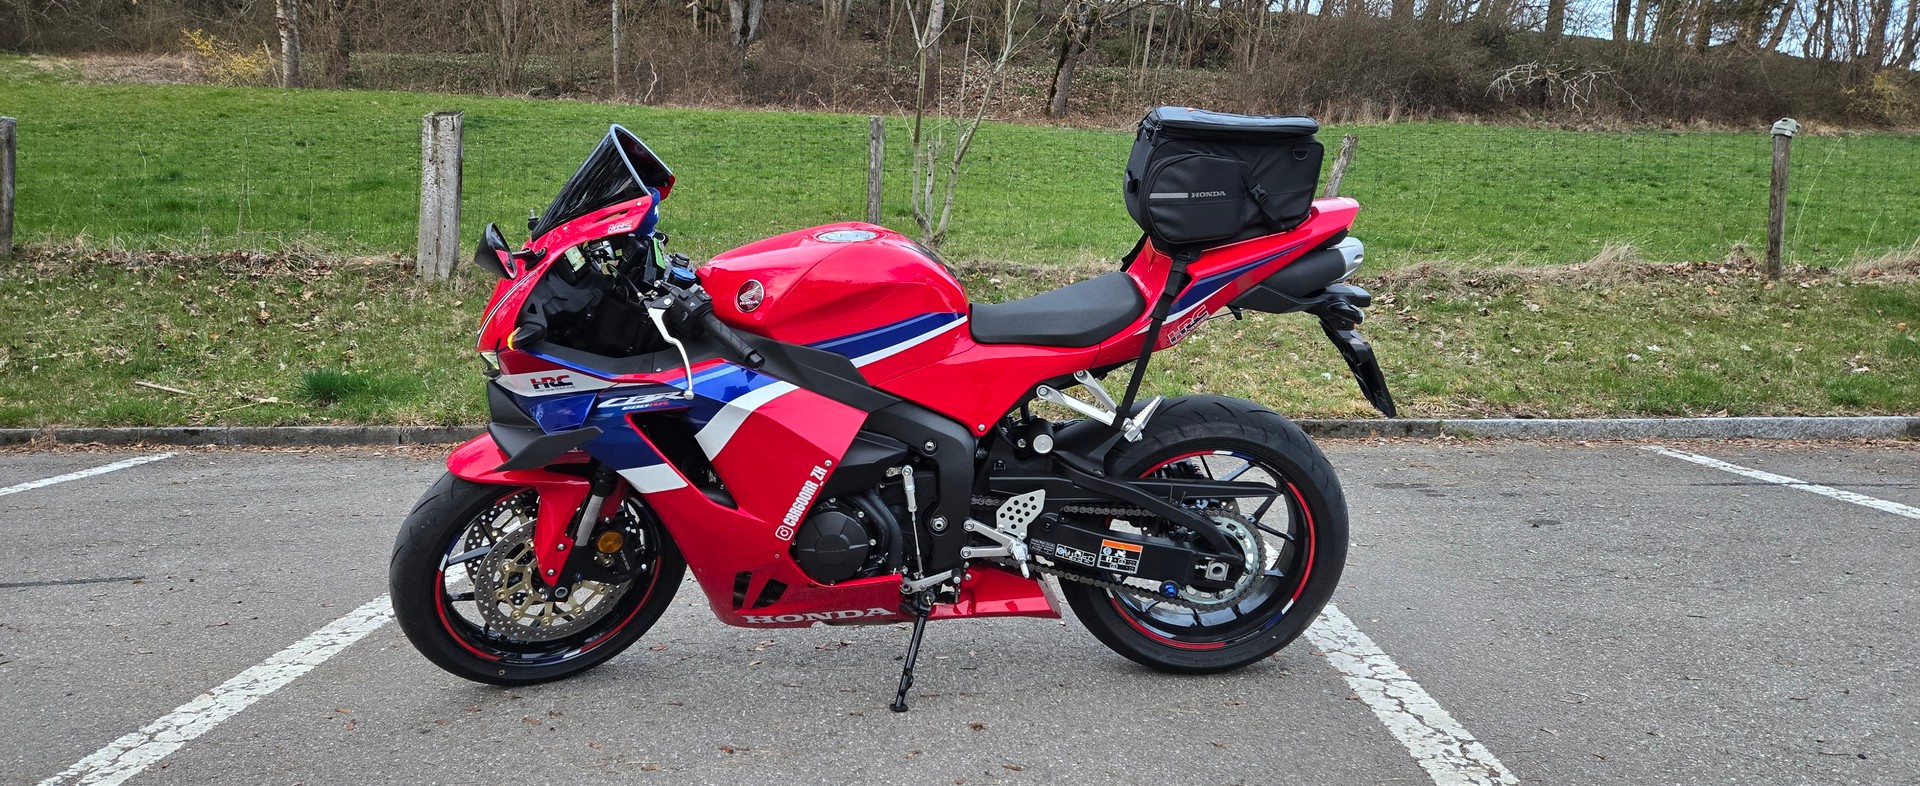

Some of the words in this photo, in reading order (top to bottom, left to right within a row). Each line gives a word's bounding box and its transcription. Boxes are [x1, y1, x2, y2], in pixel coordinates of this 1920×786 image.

[1191, 190, 1227, 198] HONDA
[1168, 304, 1209, 344] HRC
[530, 374, 573, 389] HRC
[597, 391, 685, 408] CBR
[621, 401, 670, 411] 600RR
[742, 607, 897, 624] HONDA
